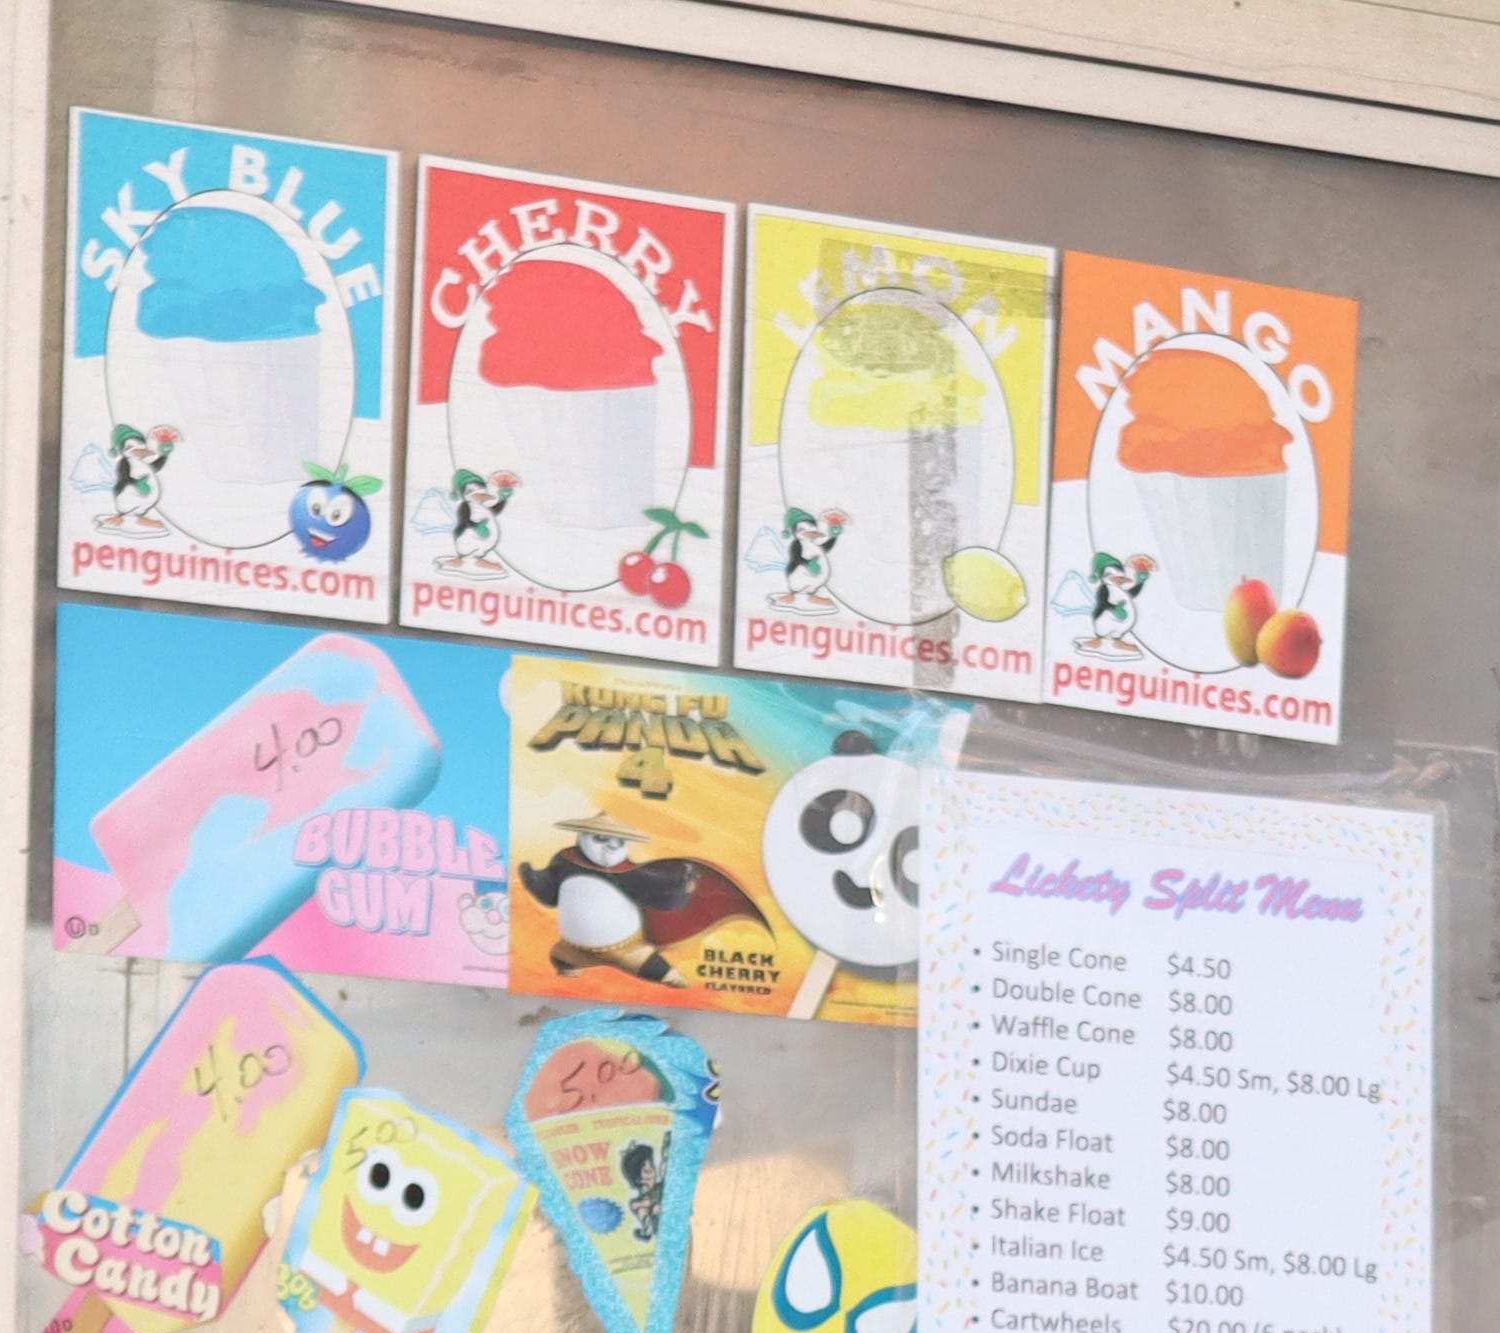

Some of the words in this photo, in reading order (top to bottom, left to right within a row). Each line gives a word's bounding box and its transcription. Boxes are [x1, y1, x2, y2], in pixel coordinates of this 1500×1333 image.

[82, 146, 190, 292] SKY
[229, 144, 382, 306] BLUE
[431, 199, 715, 338] CHERRY
[1075, 289, 1332, 423] MANGO
[71, 538, 375, 600] penguinices.com
[412, 582, 708, 644] penguinices.com
[747, 614, 1032, 675] penguinices.com
[561, 680, 667, 714] KUNG
[677, 694, 729, 717] FU
[1053, 659, 1331, 726] penguinices.com
[528, 704, 767, 776] PANDA
[617, 747, 673, 800] 4
[293, 809, 508, 881] BUBBLE
[316, 868, 434, 937] GUM
[990, 853, 1131, 915] Lickety
[1144, 868, 1246, 918] Split
[1255, 875, 1363, 921] Menu
[697, 965, 781, 984] CHERRY
[704, 948, 774, 966] BLACK
[992, 942, 1060, 969] Single
[1069, 948, 1127, 972] Cone
[1167, 953, 1231, 980] $4.50
[993, 979, 1076, 1005] Double
[1083, 986, 1141, 1010] Cone
[1169, 991, 1232, 1016] $8.00
[993, 1015, 1070, 1042] Waffle
[1077, 1022, 1135, 1045] Cone
[1169, 1027, 1233, 1052] $8.00
[993, 1052, 1049, 1078] Dixie
[1056, 1057, 1100, 1081] Cup
[1167, 1063, 1229, 1089] $4.50
[1238, 1068, 1278, 1095] Sm,
[1287, 1071, 1349, 1097] $8.00
[1358, 1077, 1380, 1103] Lg
[991, 1090, 1077, 1115] Sundae
[1163, 1100, 1227, 1125] $8.00
[991, 1127, 1047, 1149] Soda
[1056, 1129, 1113, 1153] Float
[1166, 1136, 1229, 1161] $8.00
[992, 1163, 1111, 1189] Milkshake
[1166, 1172, 1230, 1197] $8.00
[41, 1190, 212, 1267] Cotton
[991, 1200, 1060, 1224] Shake
[1069, 1203, 1125, 1227] Float
[1166, 1209, 1229, 1233] $9.00
[54, 1238, 222, 1321] Candy
[991, 1237, 1063, 1260] Italian
[1071, 1243, 1104, 1262] Ice
[1163, 1245, 1227, 1270] $4.50
[1234, 1251, 1275, 1276] Sm,
[1283, 1252, 1345, 1276] $8.00
[1353, 1256, 1377, 1284] Lg
[991, 1274, 1079, 1298] Banana
[1087, 1279, 1138, 1300] Boat
[1166, 1281, 1244, 1307] $10.00
